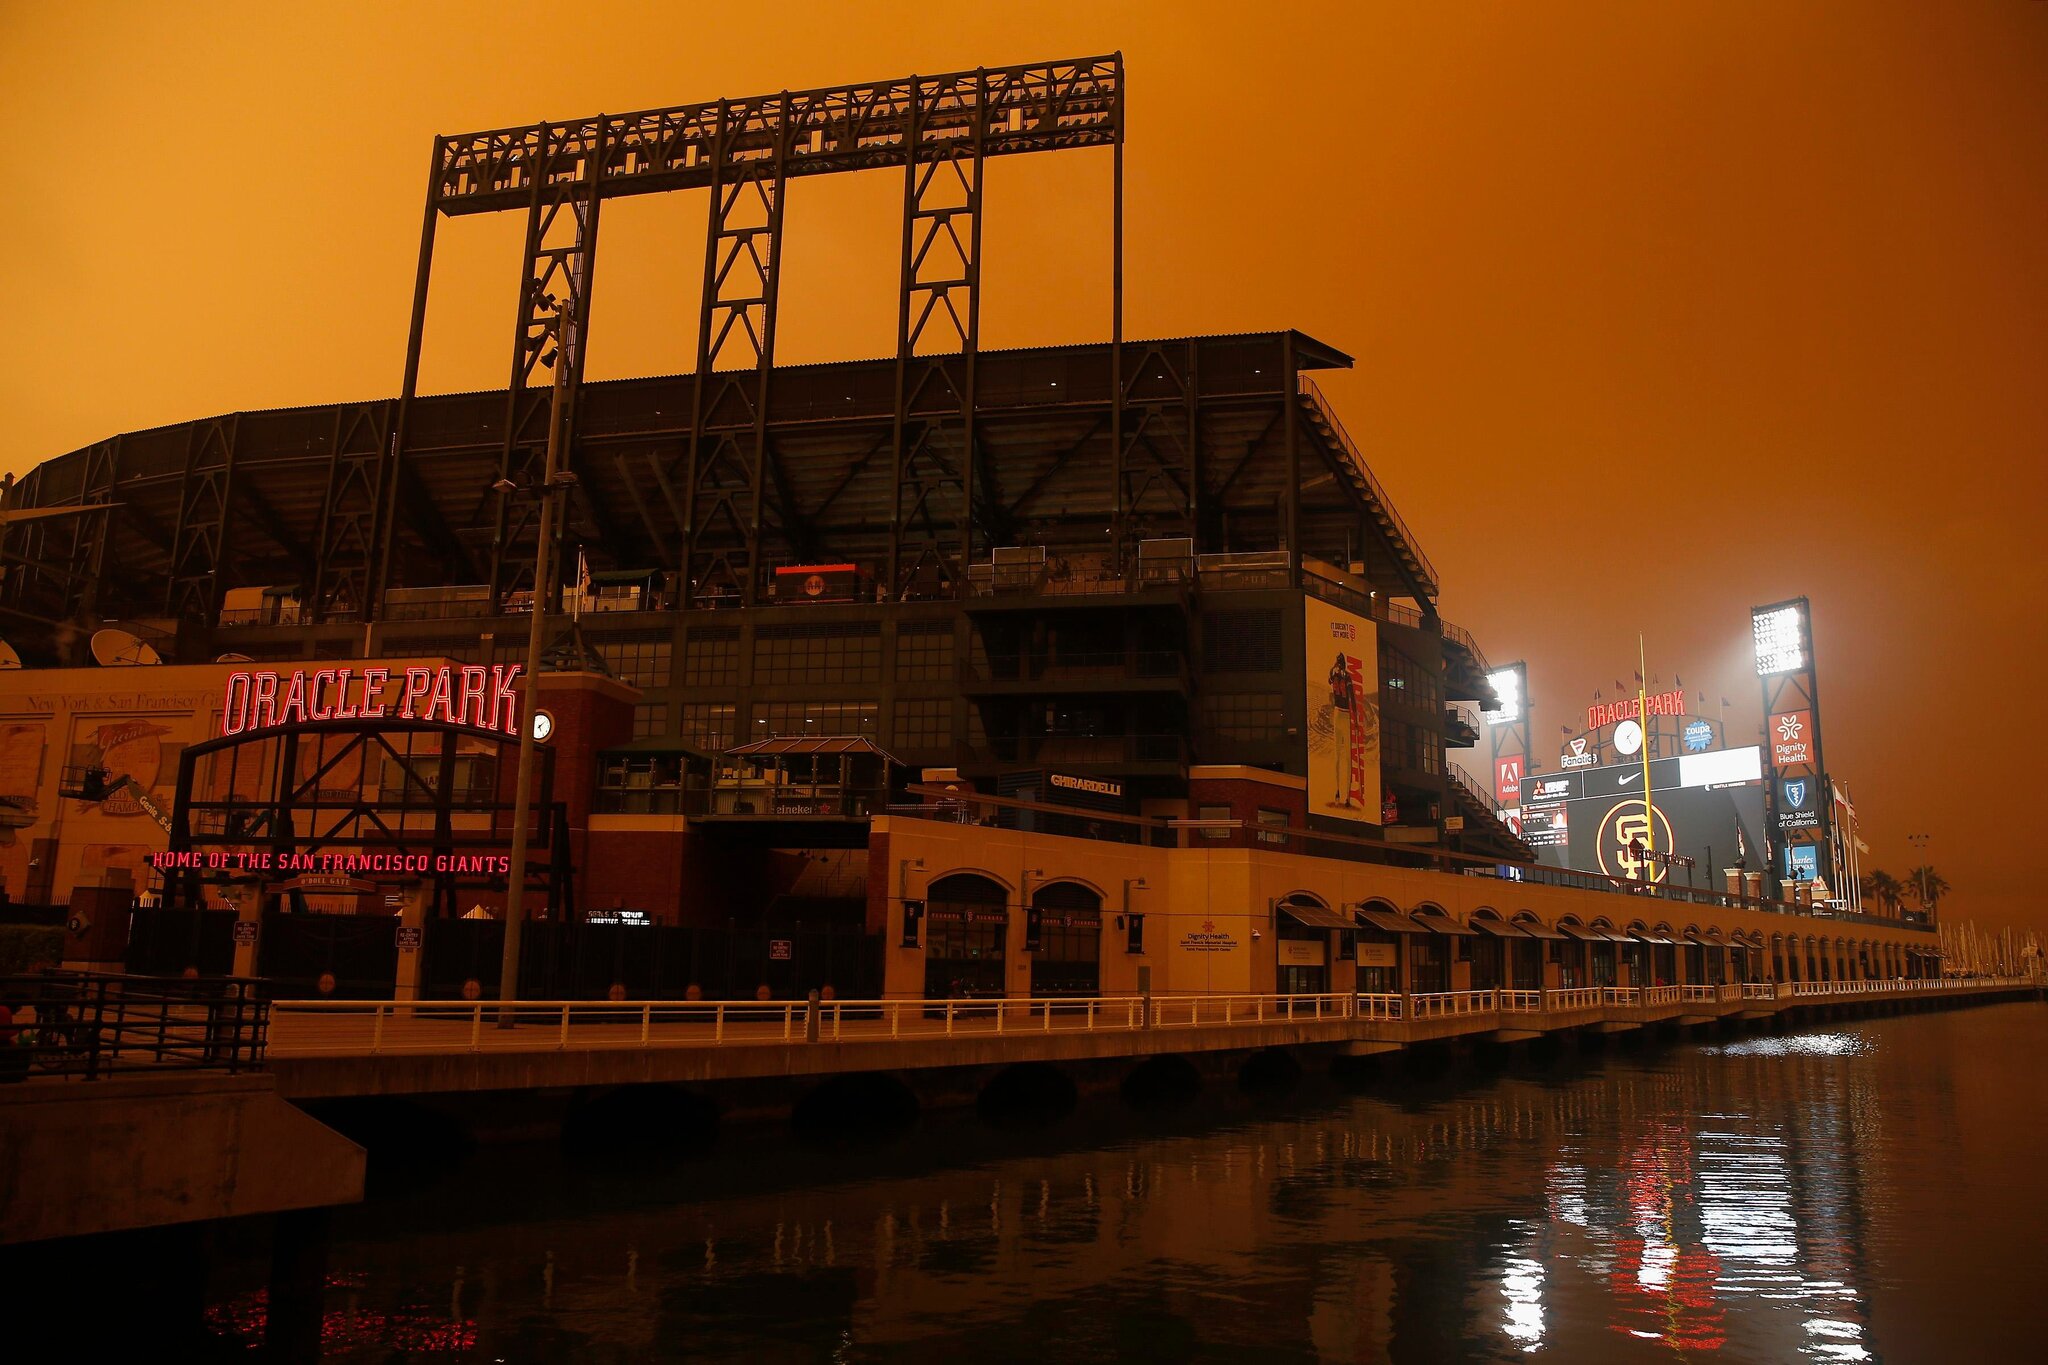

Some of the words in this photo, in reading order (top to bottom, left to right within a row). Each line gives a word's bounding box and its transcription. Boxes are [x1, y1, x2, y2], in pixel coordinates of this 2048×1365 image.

[222, 667, 390, 737] ORACLE
[402, 663, 523, 736] PARK
[1587, 698, 1641, 731] ORACLE
[1645, 690, 1686, 716] PARK
[1685, 725, 1710, 735] coupa
[1776, 742, 1807, 755] Dignity
[1561, 752, 1598, 768] Fanatics
[1050, 774, 1121, 796] GHIRARDELLI
[1502, 784, 1518, 793] Adobe
[139, 795, 158, 818] Genie
[158, 816, 173, 835] S-6
[1795, 810, 1815, 819] Shield
[1786, 818, 1818, 828] California
[153, 851, 201, 868] HOME
[209, 852, 230, 868] OF
[237, 852, 271, 869] THE
[278, 853, 315, 870] SAN
[321, 853, 429, 872] FRANCISCO
[435, 855, 511, 873] GIANTS
[329, 877, 351, 886] GATE
[1187, 933, 1208, 941] Dignity
